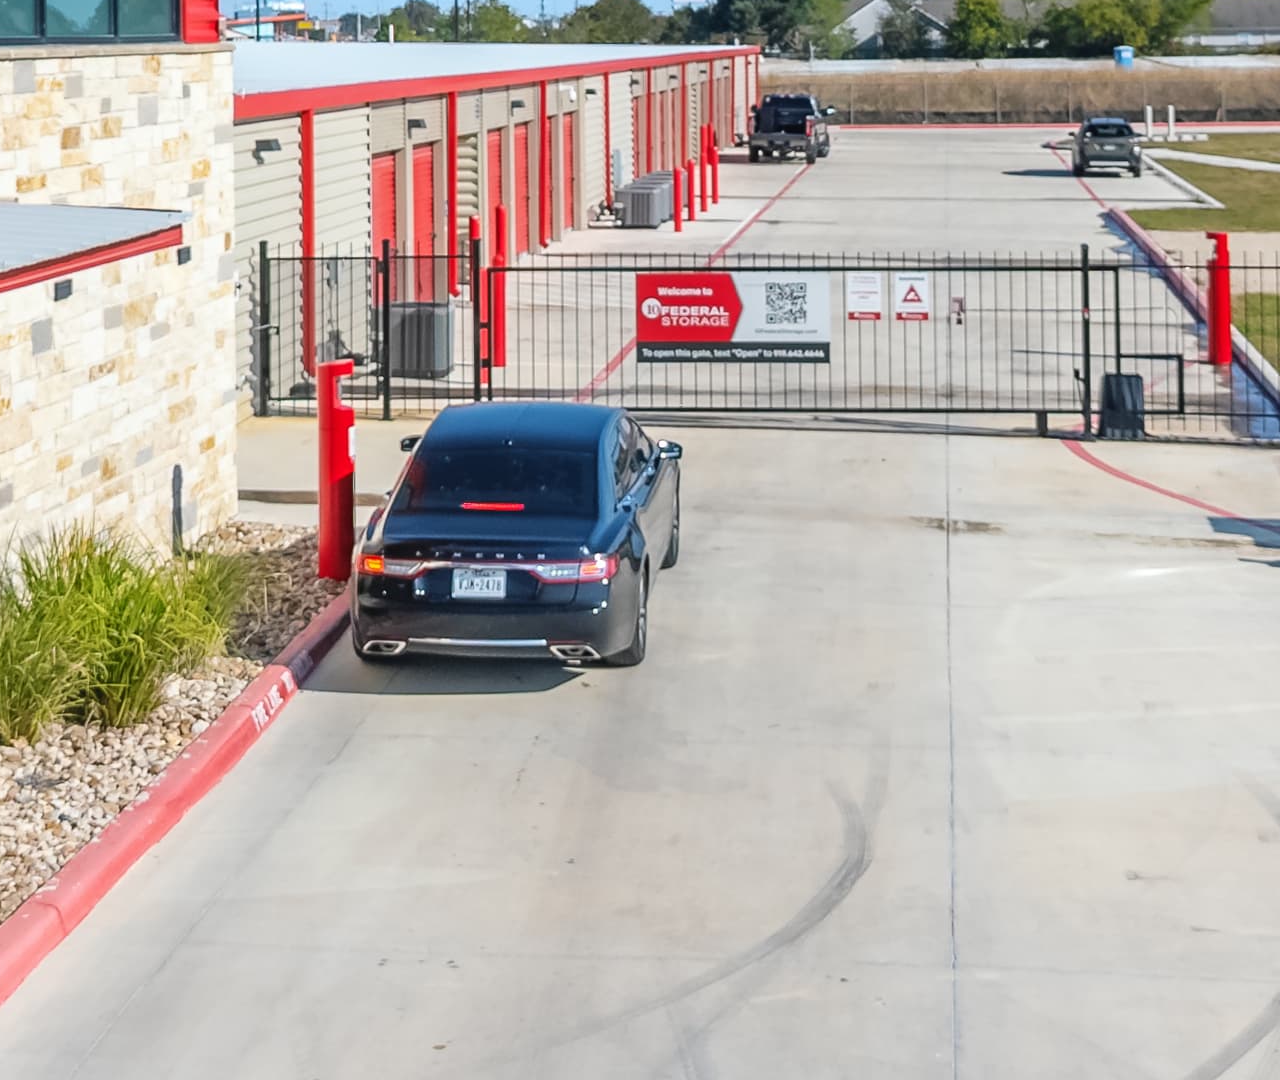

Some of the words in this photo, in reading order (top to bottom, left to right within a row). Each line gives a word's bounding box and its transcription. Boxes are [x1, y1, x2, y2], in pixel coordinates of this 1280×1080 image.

[657, 286, 701, 296] Welcome
[702, 286, 713, 296] to
[661, 306, 730, 316] FEDERAL
[661, 316, 730, 327] STORAGE
[642, 348, 653, 358] To
[653, 349, 674, 359] open
[675, 348, 691, 358] this
[691, 349, 713, 359] gate,
[713, 349, 731, 358] text
[731, 348, 762, 359] "Open"
[763, 349, 772, 358] to
